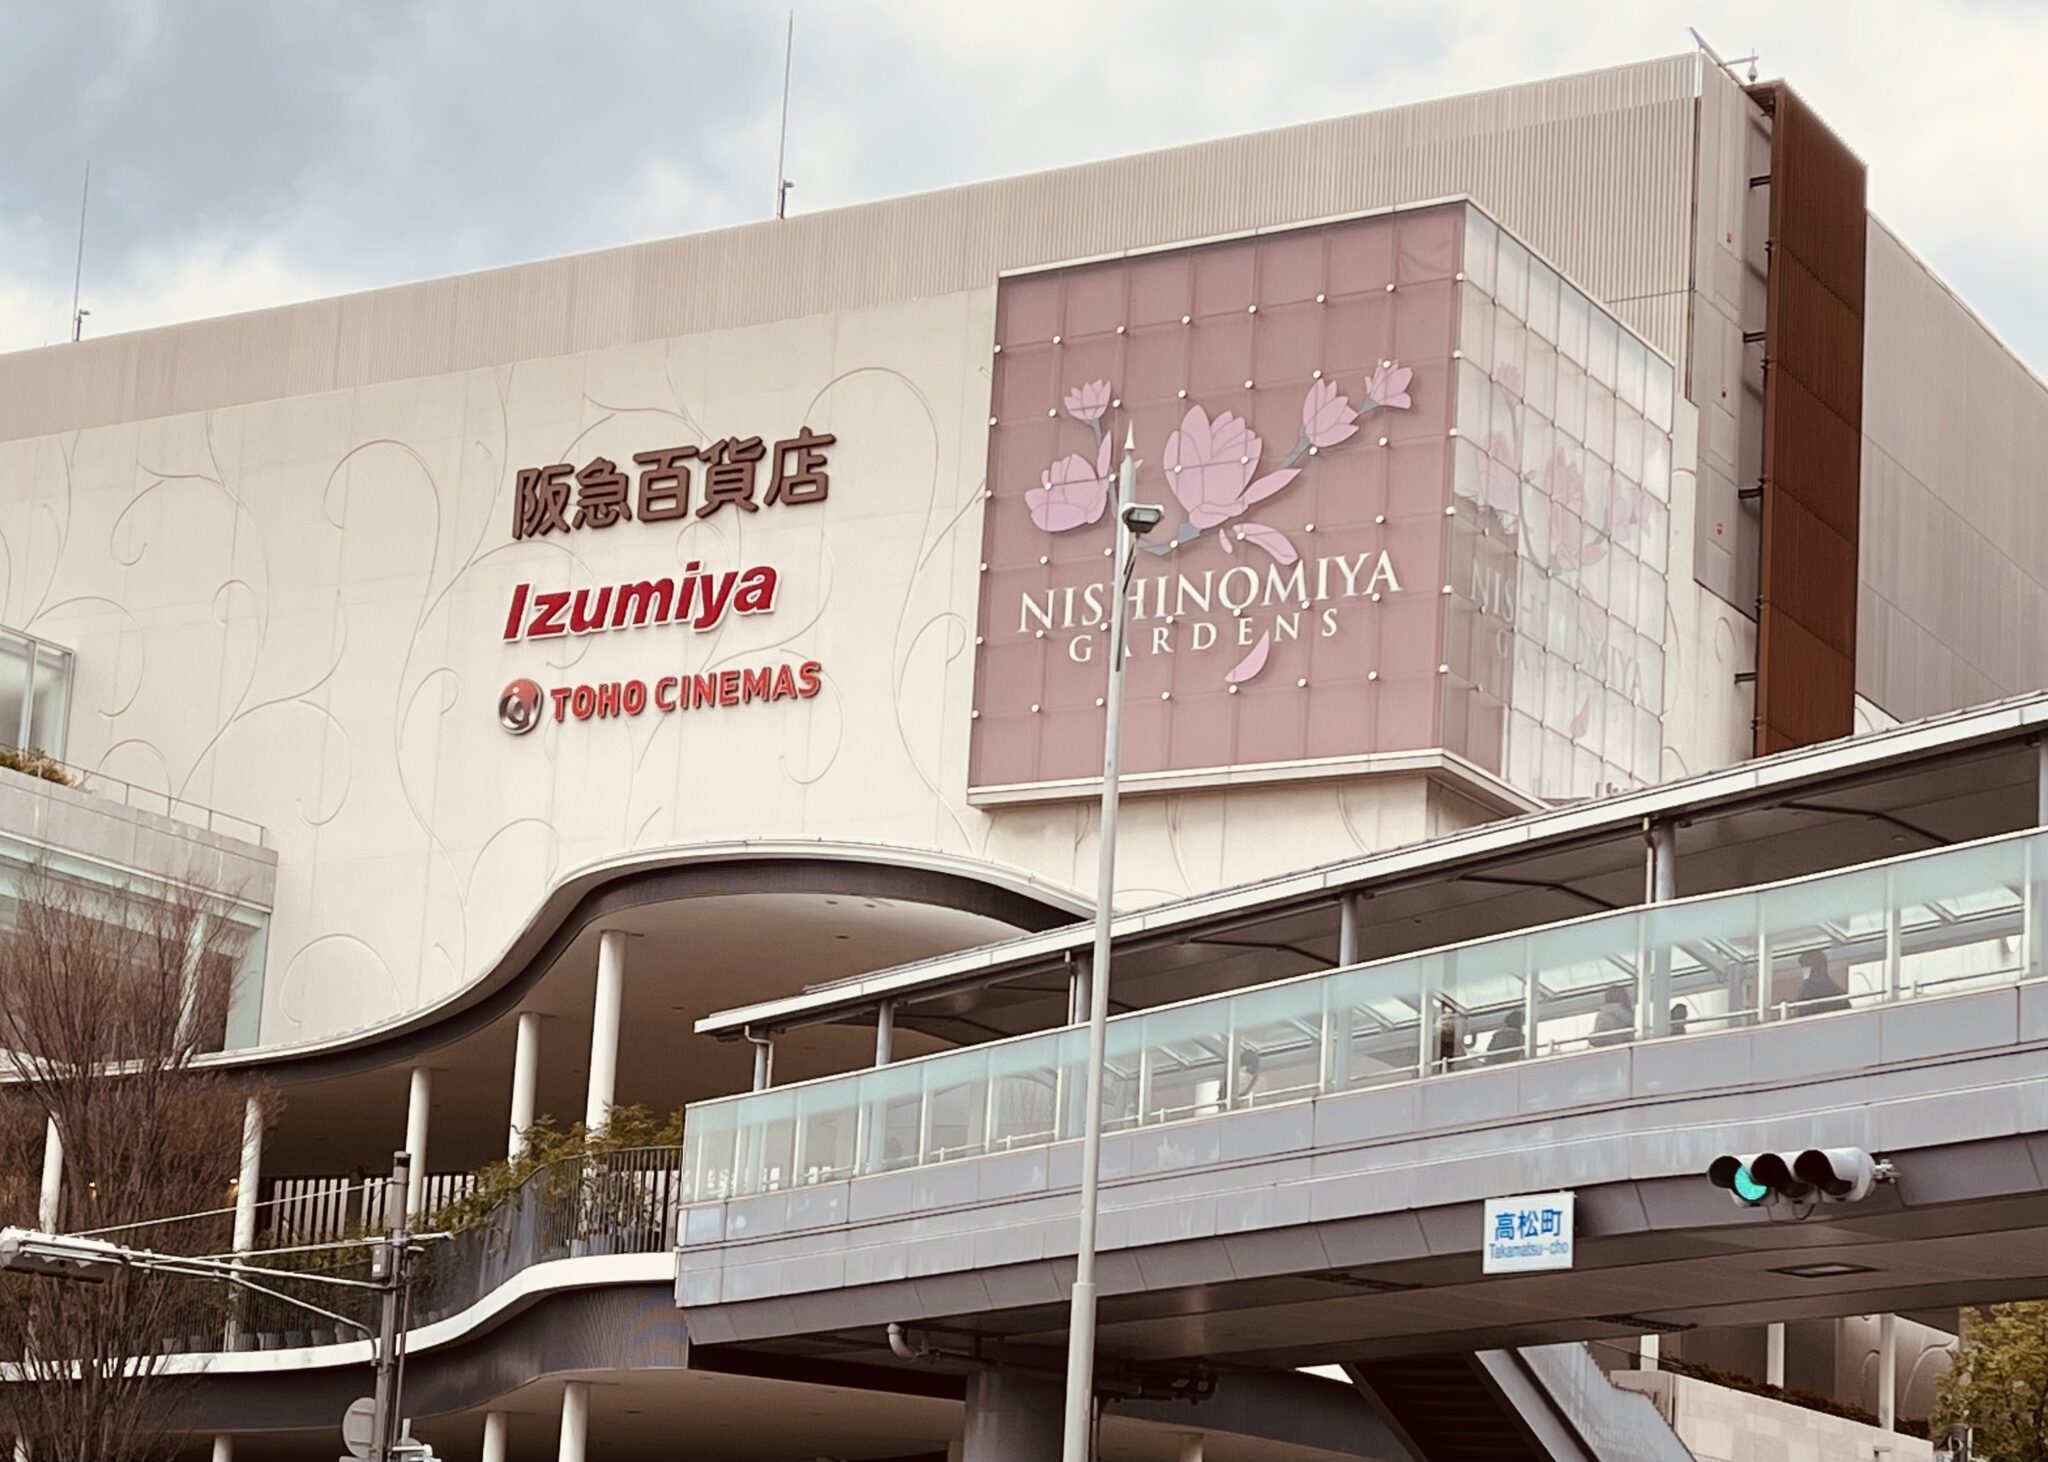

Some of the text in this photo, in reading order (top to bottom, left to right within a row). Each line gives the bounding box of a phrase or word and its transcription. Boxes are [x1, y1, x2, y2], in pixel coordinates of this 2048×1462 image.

[512, 426, 837, 540] 阪急百貨店
[503, 561, 778, 641] Izumiya
[1068, 607, 1340, 663] GRDENS
[550, 661, 822, 723] TOHO CINEMAS
[1489, 1240, 1569, 1259] Takamatsu-cho
[1494, 1208, 1563, 1241] 高松町
